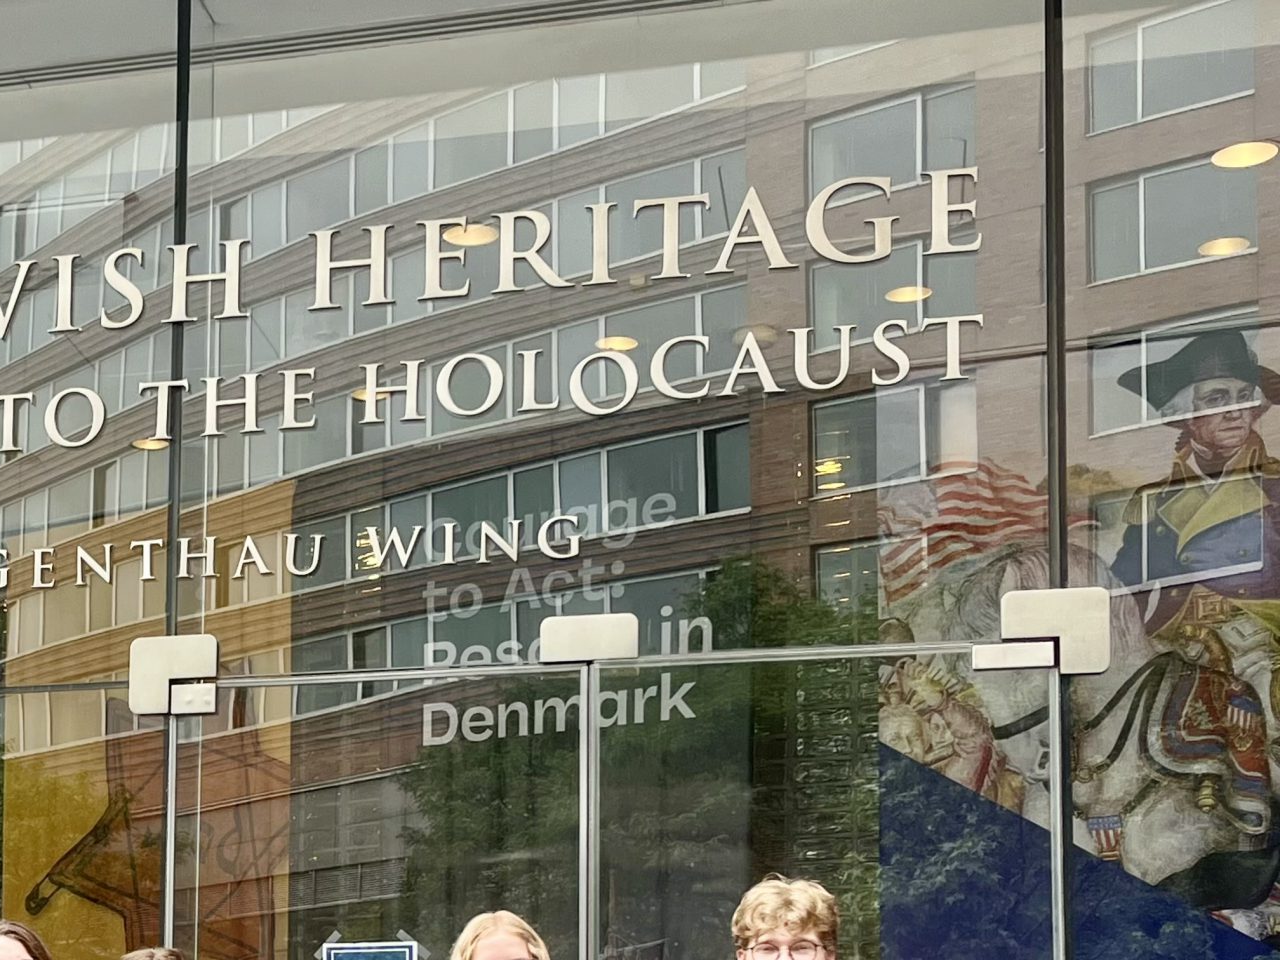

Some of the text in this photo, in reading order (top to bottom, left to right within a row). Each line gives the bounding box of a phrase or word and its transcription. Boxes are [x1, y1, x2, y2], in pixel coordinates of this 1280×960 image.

[308, 166, 984, 311] HERITAGE
[138, 367, 317, 441] THE
[358, 313, 984, 425] HOLOCAUST
[364, 515, 585, 569] WING
[424, 491, 678, 563] Courage
[422, 557, 626, 622] to Act:
[660, 605, 713, 657] in
[422, 673, 697, 746] Denmark
